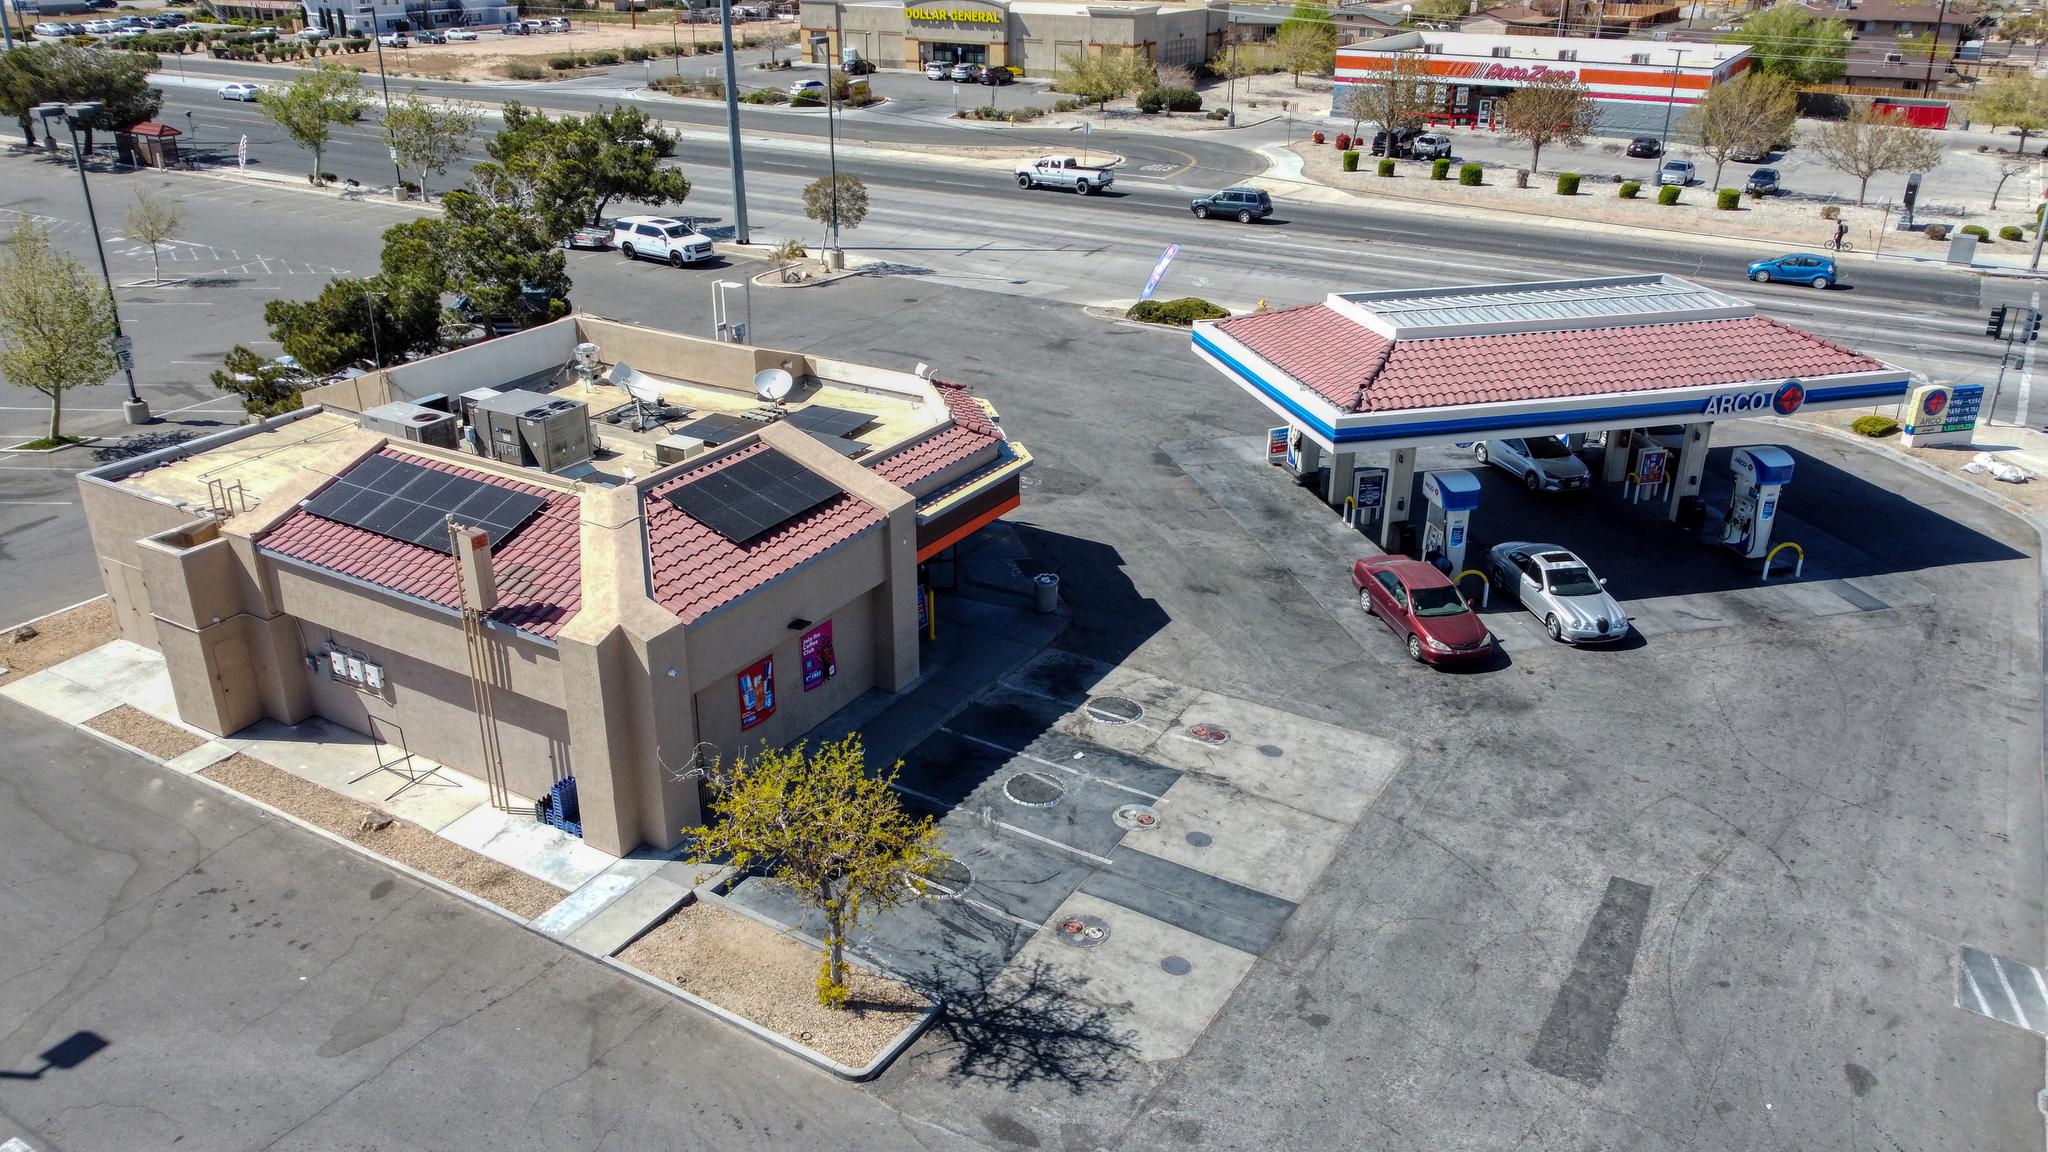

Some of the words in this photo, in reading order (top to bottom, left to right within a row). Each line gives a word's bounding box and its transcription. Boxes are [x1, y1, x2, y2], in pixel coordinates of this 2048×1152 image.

[905, 8, 947, 20] DOLLAR
[951, 10, 1000, 23] GENERAL
[1703, 392, 1766, 416] ARCO
[1920, 417, 1942, 425] ARCO
